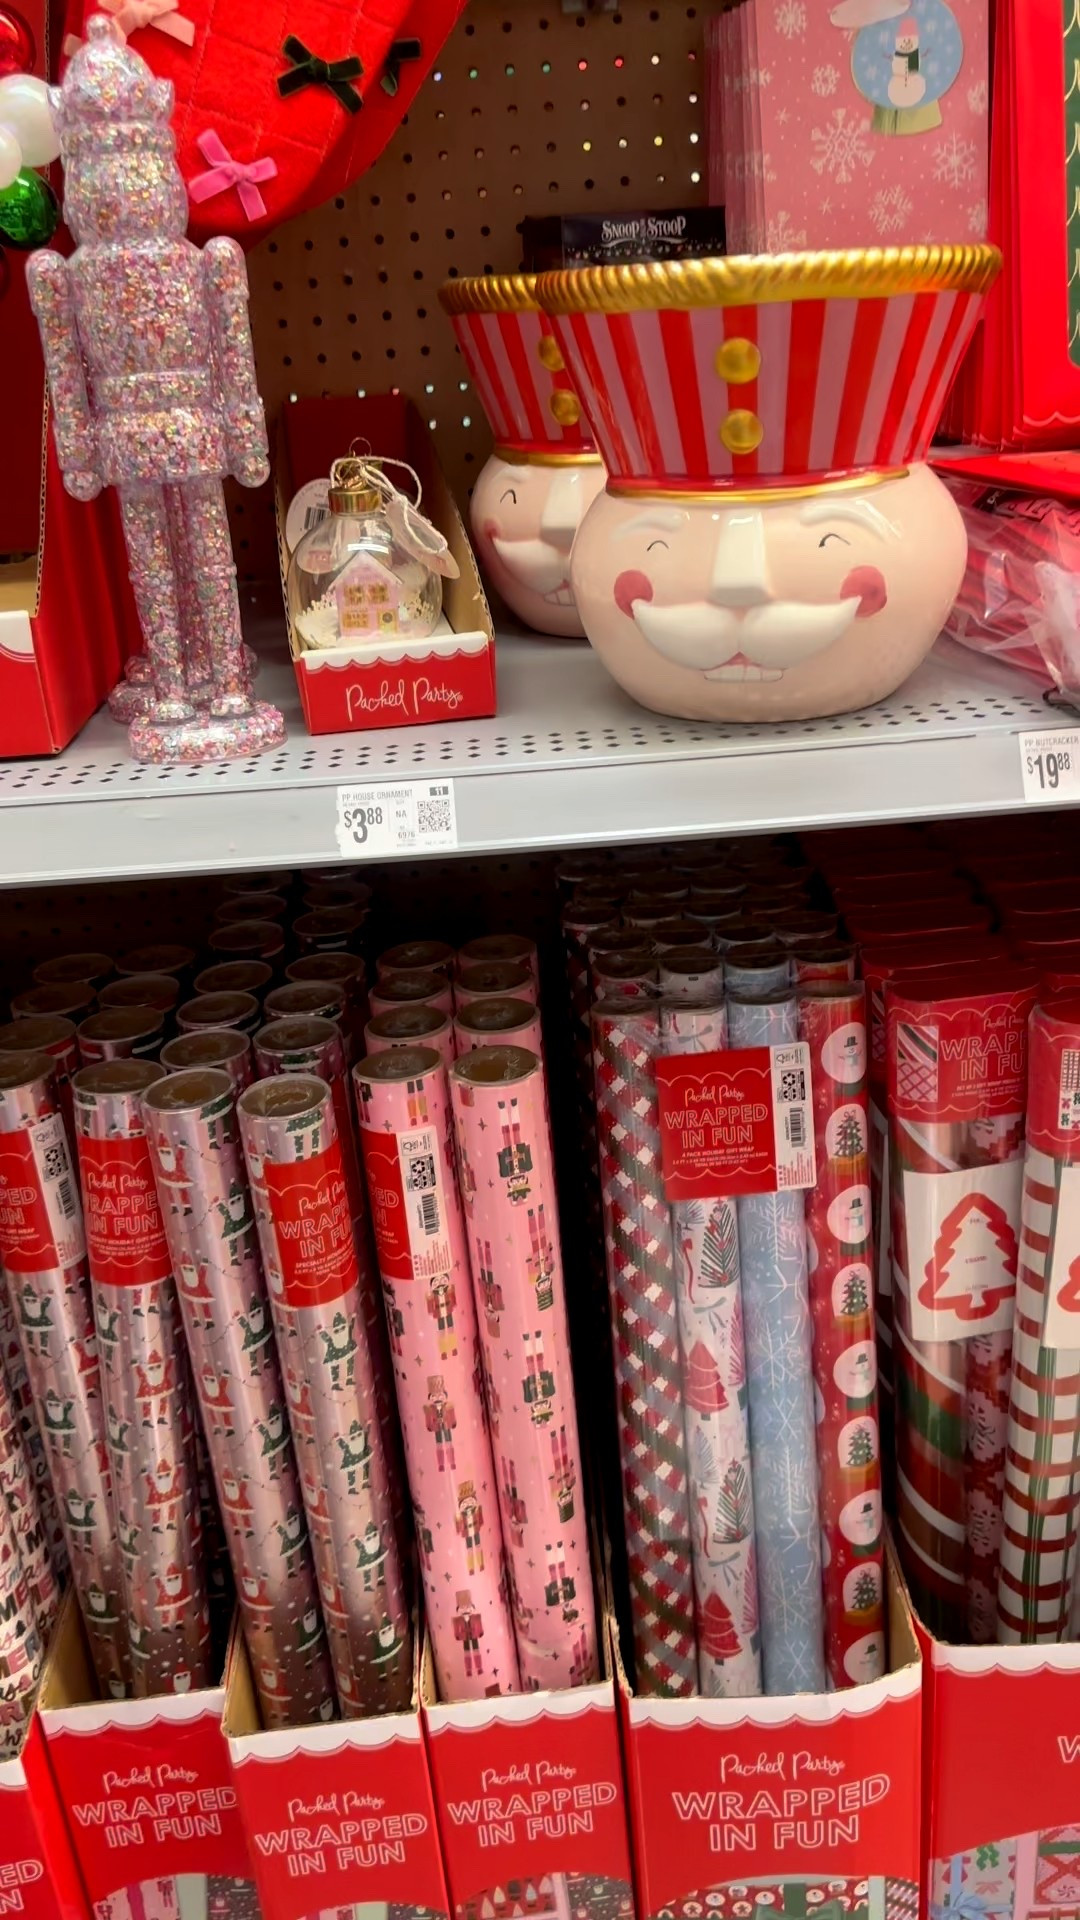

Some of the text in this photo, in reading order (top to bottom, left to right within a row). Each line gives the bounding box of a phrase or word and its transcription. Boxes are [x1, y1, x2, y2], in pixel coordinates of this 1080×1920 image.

[646, 216, 686, 238] STOOP
[346, 679, 409, 722] Packed
[961, 1057, 988, 1081] IN
[664, 1103, 768, 1130] WRAPPED
[681, 1124, 753, 1150] IN FUN
[113, 1210, 158, 1236] FUN
[300, 1235, 325, 1259] IN
[103, 1766, 156, 1794] Packed
[481, 1762, 533, 1793] Packed
[720, 1750, 844, 1784] Packed Party
[72, 1786, 240, 1827] WRAPPED
[287, 1792, 341, 1822] Packed
[447, 1781, 618, 1825] WRAPPED
[671, 1773, 890, 1821] WRAPPED
[105, 1813, 222, 1848] IN FUN
[254, 1812, 428, 1856] WRAPPED
[477, 1810, 594, 1848] IN FUN
[709, 1814, 860, 1852] IN FUN
[287, 1841, 406, 1877] IN FUN
